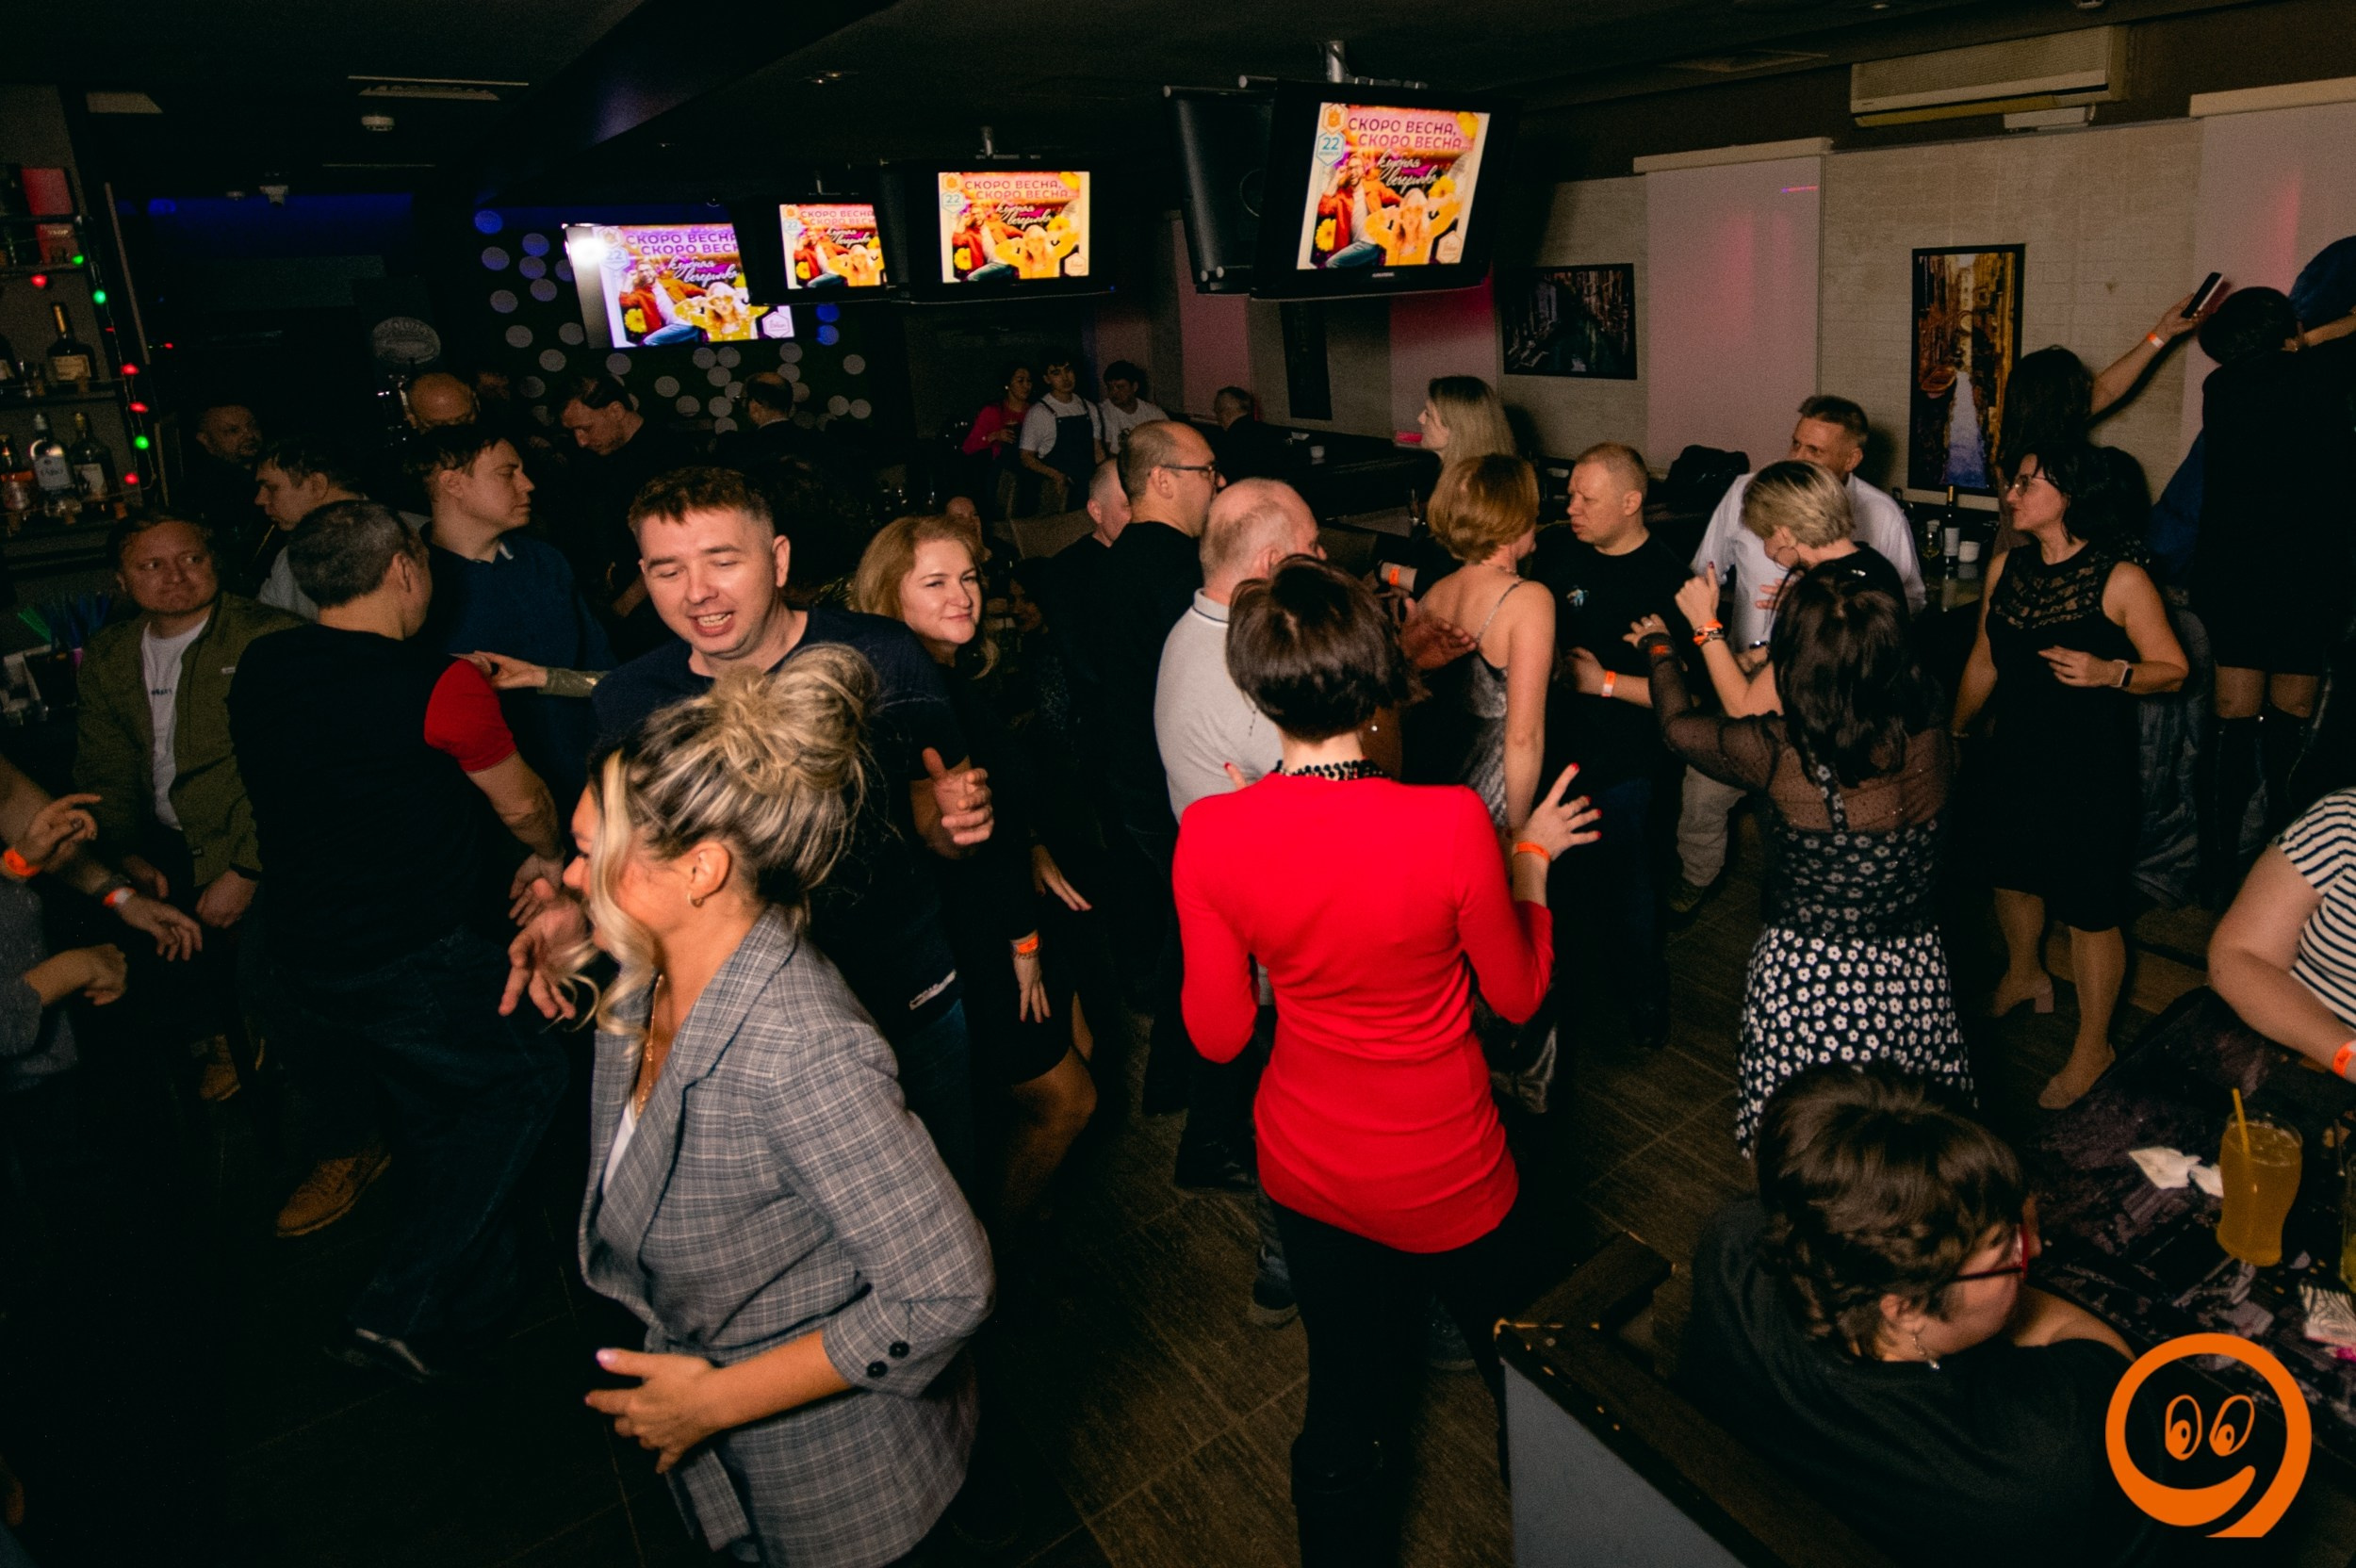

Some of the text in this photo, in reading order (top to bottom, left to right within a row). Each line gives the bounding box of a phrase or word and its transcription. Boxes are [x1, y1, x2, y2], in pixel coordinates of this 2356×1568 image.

[1349, 118, 1457, 136] СКОРО ВЕСНА,
[1322, 137, 1340, 151] 22
[1359, 134, 1410, 147] СКОРО
[965, 180, 1062, 189] СКОРО ВЕСНА,
[945, 194, 960, 204] 22
[975, 189, 1022, 200] СКОРО
[626, 234, 682, 245] СКОРО
[641, 244, 696, 255] СКОРО
